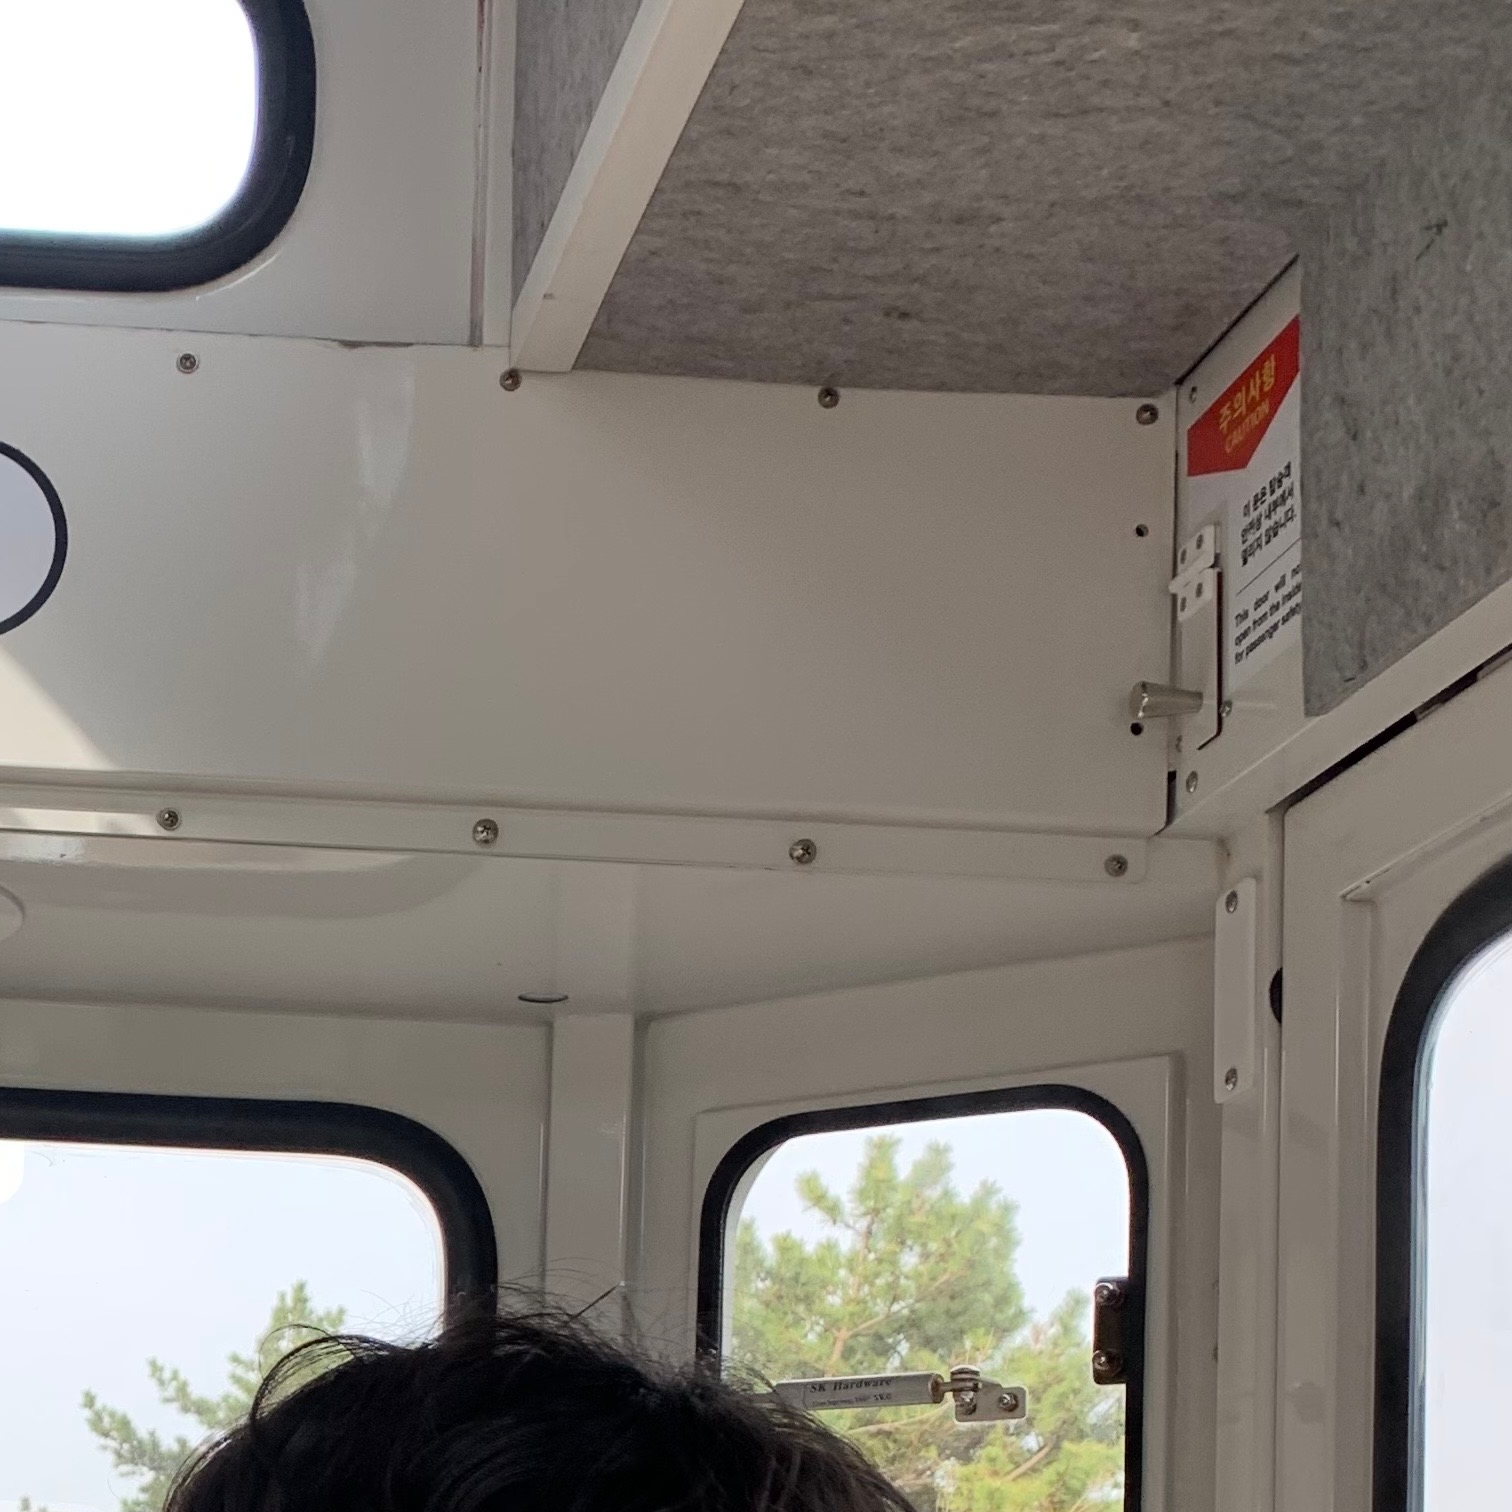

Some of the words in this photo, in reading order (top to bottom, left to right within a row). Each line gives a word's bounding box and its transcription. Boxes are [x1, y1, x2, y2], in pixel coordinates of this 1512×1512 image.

[1219, 354, 1276, 434] 주의사항
[1224, 399, 1270, 454] CAUTION
[1234, 608, 1250, 629] This
[1253, 590, 1270, 612] door
[1274, 573, 1287, 593] will
[1234, 625, 1252, 647] open
[1252, 610, 1269, 632] from
[809, 1382, 828, 1394] SK
[833, 1376, 894, 1391] Hardware
